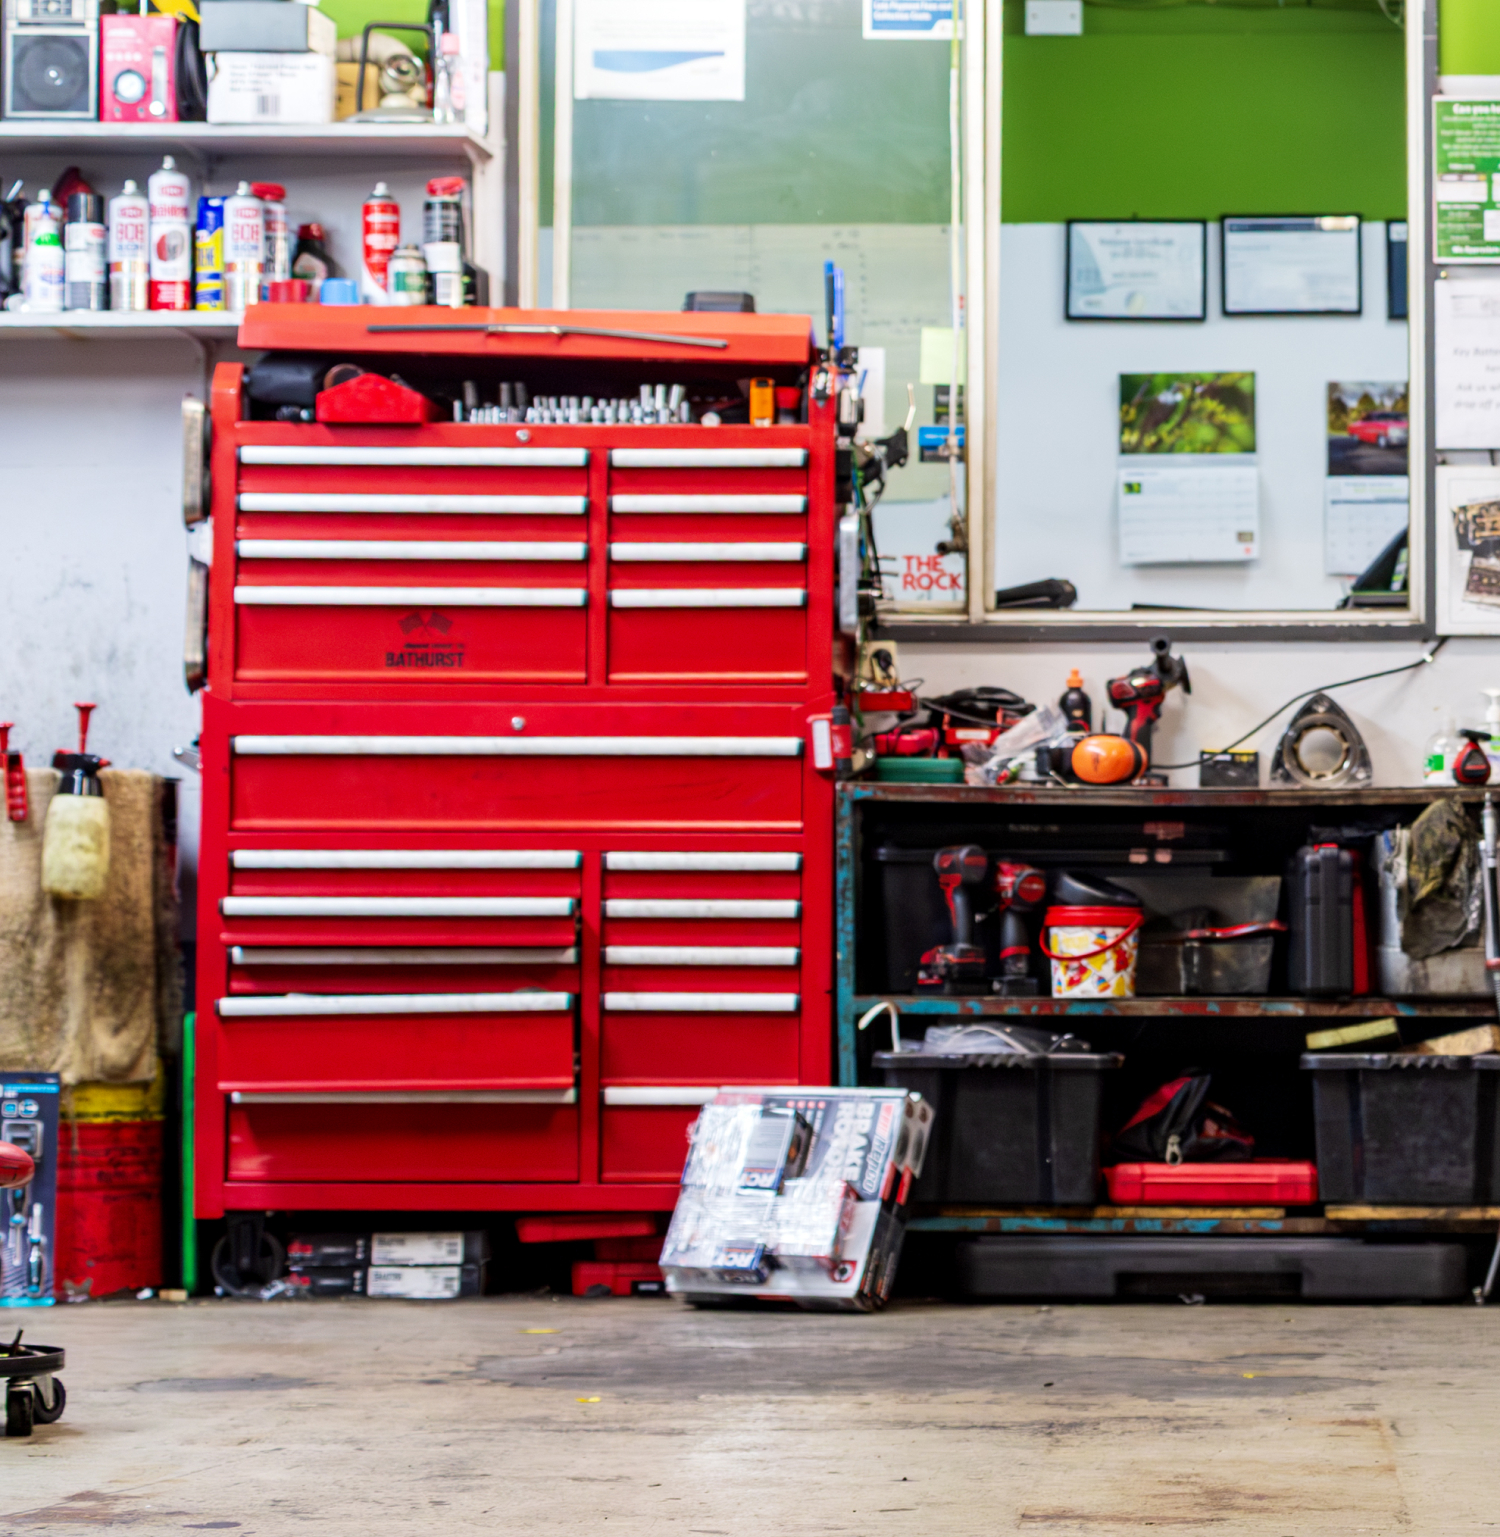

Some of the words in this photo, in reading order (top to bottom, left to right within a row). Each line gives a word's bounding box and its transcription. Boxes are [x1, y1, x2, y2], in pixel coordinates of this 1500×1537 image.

[1453, 103, 1471, 114] Can
[1472, 105, 1489, 115] you
[902, 555, 944, 573] THE
[903, 573, 962, 590] ROCK
[385, 652, 464, 668] BATHURST
[842, 1102, 875, 1182] BRAKE
[863, 1138, 889, 1194] Repco
